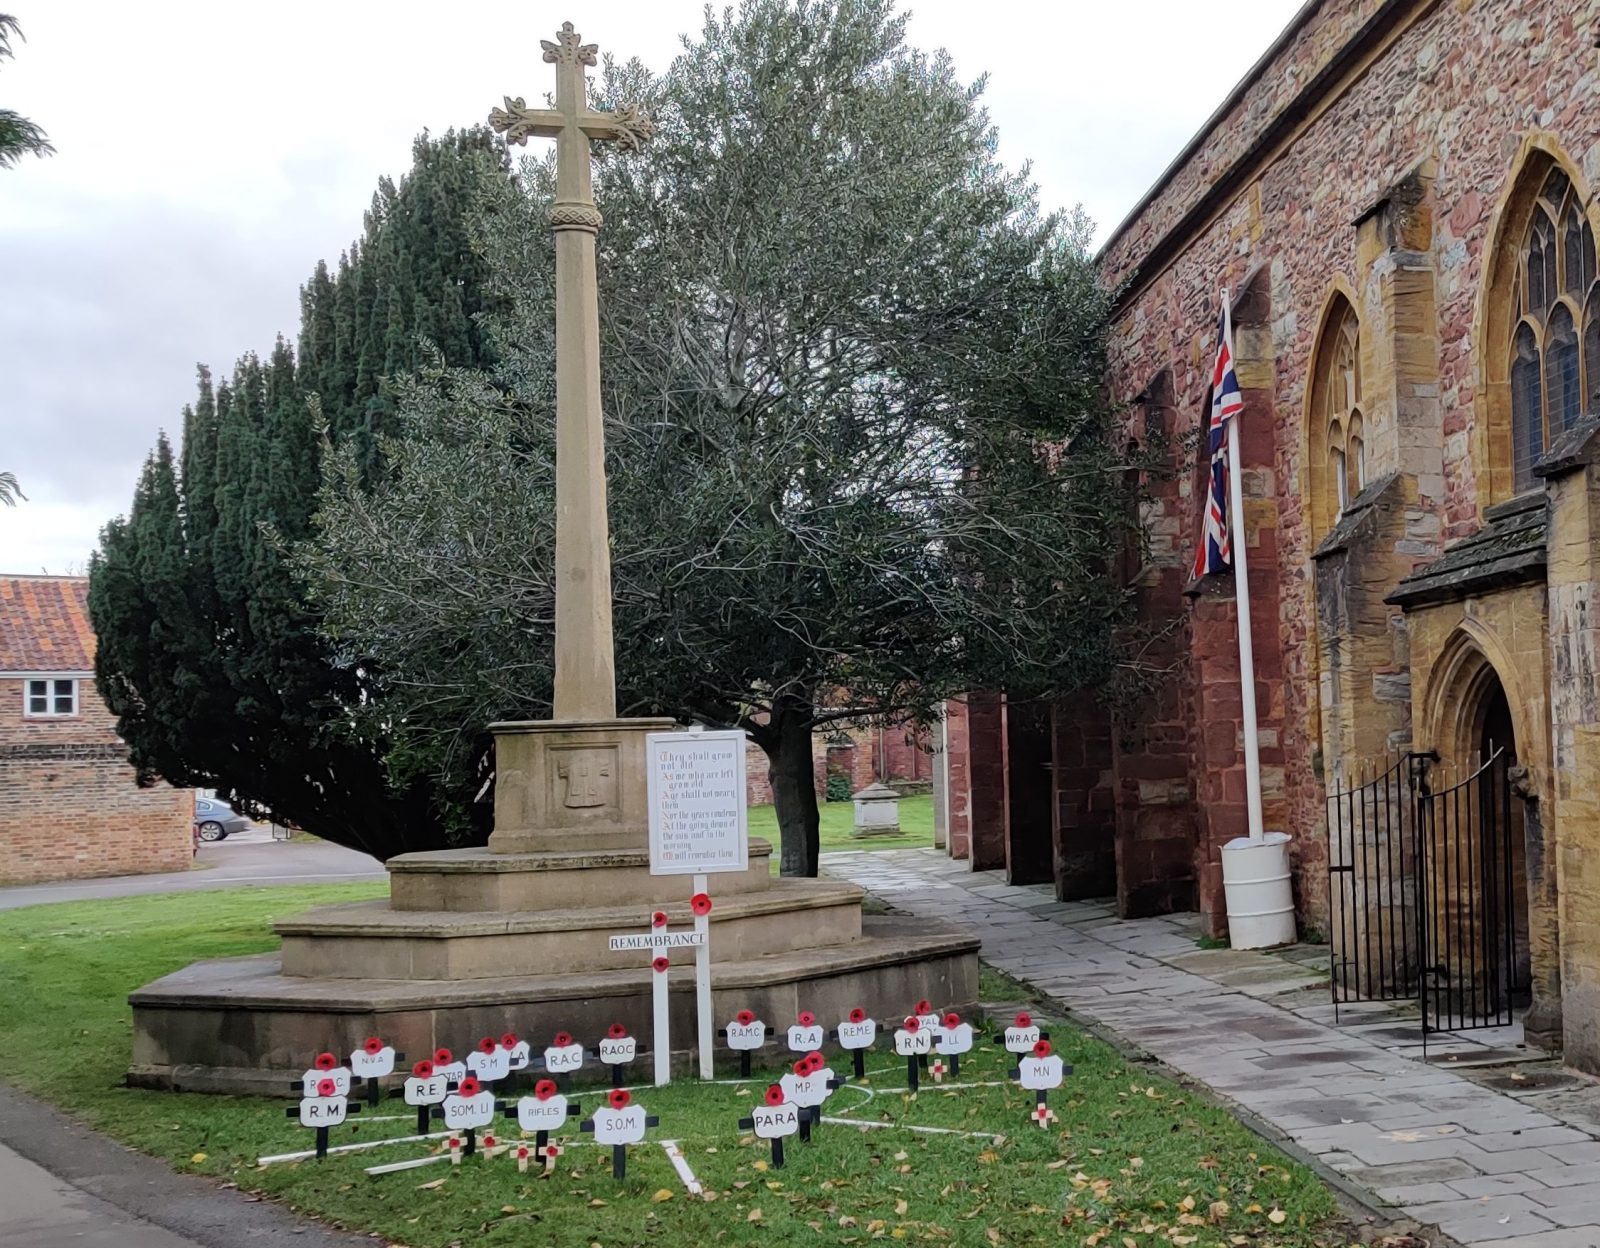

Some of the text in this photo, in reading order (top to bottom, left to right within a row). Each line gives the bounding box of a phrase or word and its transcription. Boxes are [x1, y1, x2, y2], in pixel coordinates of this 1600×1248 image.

[688, 751, 708, 760] shall
[712, 752, 732, 762] grow
[661, 760, 692, 770] not old
[688, 770, 704, 780] who
[721, 769, 734, 778] left
[669, 782, 689, 791] grow
[664, 791, 678, 801] Age
[682, 790, 700, 798] shall
[702, 790, 712, 798] not
[662, 800, 678, 809] them
[662, 811, 677, 820] Nor
[680, 811, 688, 819] the
[691, 811, 710, 820] years
[663, 822, 674, 830] At
[676, 822, 686, 830] the
[663, 832, 673, 840] the
[691, 830, 704, 839] and
[716, 830, 724, 838] the
[675, 850, 686, 860] will
[611, 933, 704, 949] REMEMBRANCE
[528, 1107, 560, 1118] RIFLES
[756, 1112, 796, 1128] PARA
